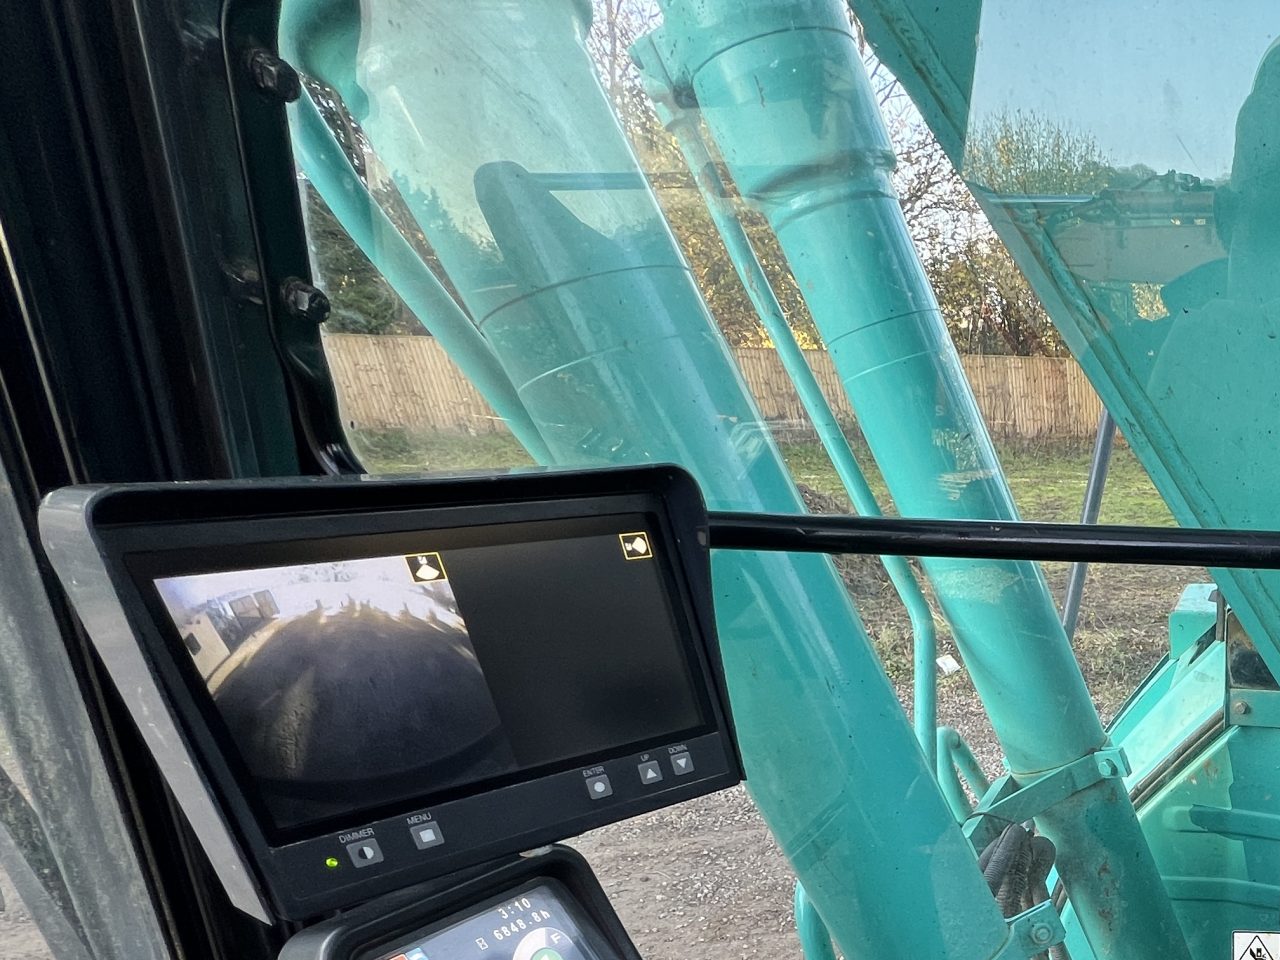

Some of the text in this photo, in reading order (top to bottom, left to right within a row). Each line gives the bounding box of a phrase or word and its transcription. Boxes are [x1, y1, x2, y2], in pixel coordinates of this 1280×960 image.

[668, 744, 688, 754] DOWN
[641, 754, 650, 762] UP
[583, 765, 605, 777] ENTER
[407, 812, 432, 825] MENU
[339, 827, 375, 843] DIMMER
[498, 897, 532, 920] 3:10
[551, 932, 561, 945] F
